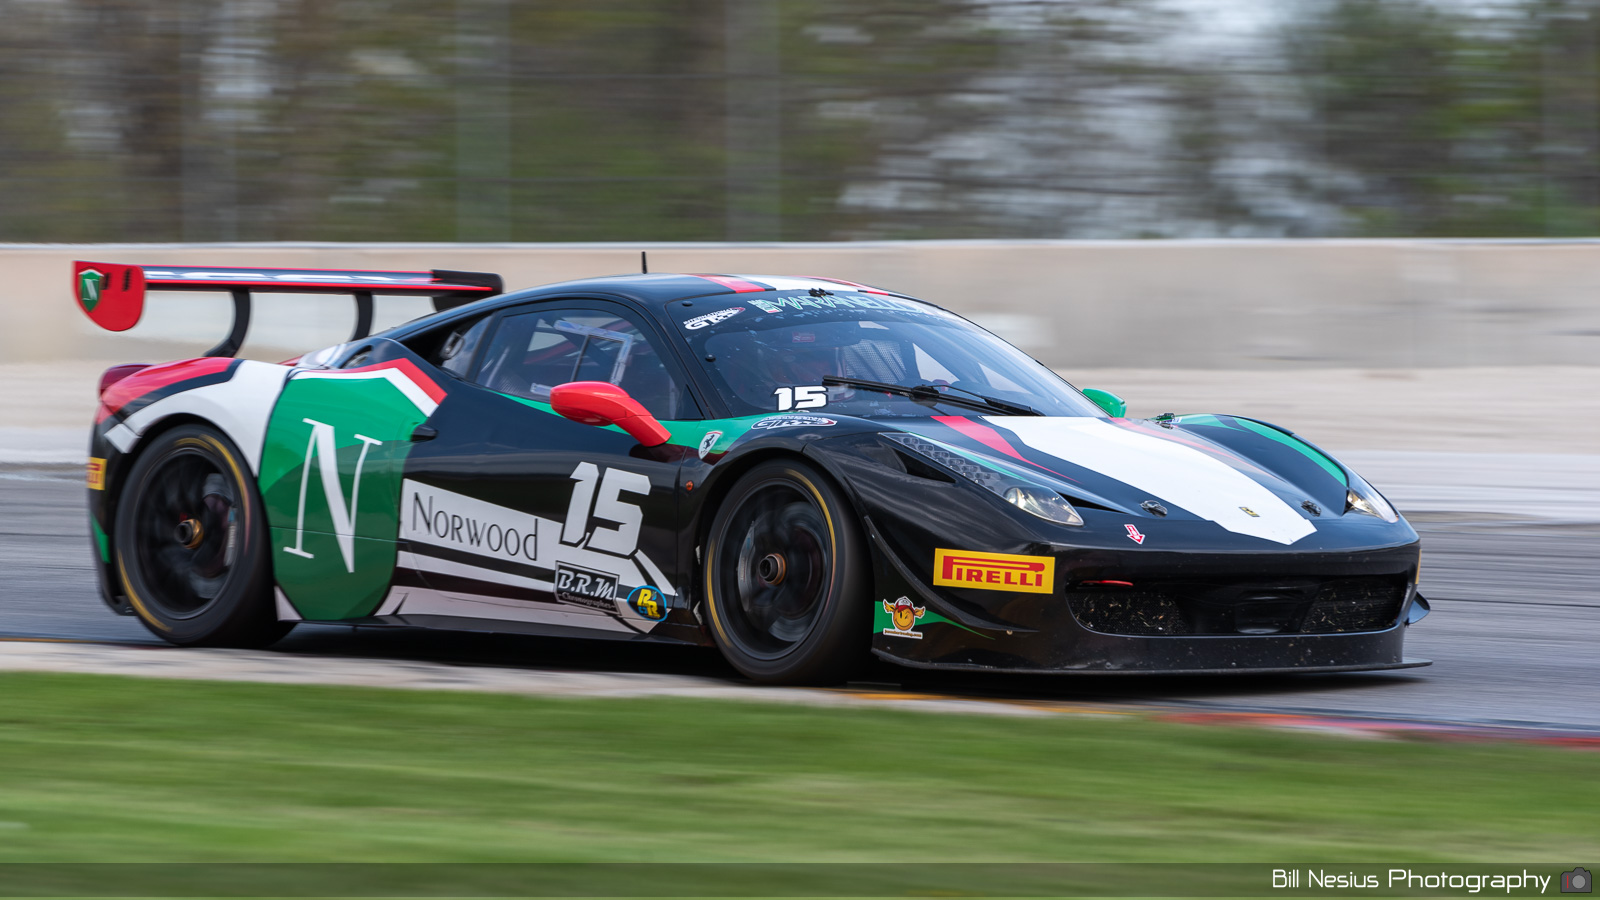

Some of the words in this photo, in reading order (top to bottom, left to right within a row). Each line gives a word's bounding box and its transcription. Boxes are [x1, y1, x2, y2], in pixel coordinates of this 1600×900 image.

[774, 386, 827, 411] 15
[283, 417, 383, 573] N
[570, 461, 651, 557] 15
[942, 555, 1045, 587] PIRELLI
